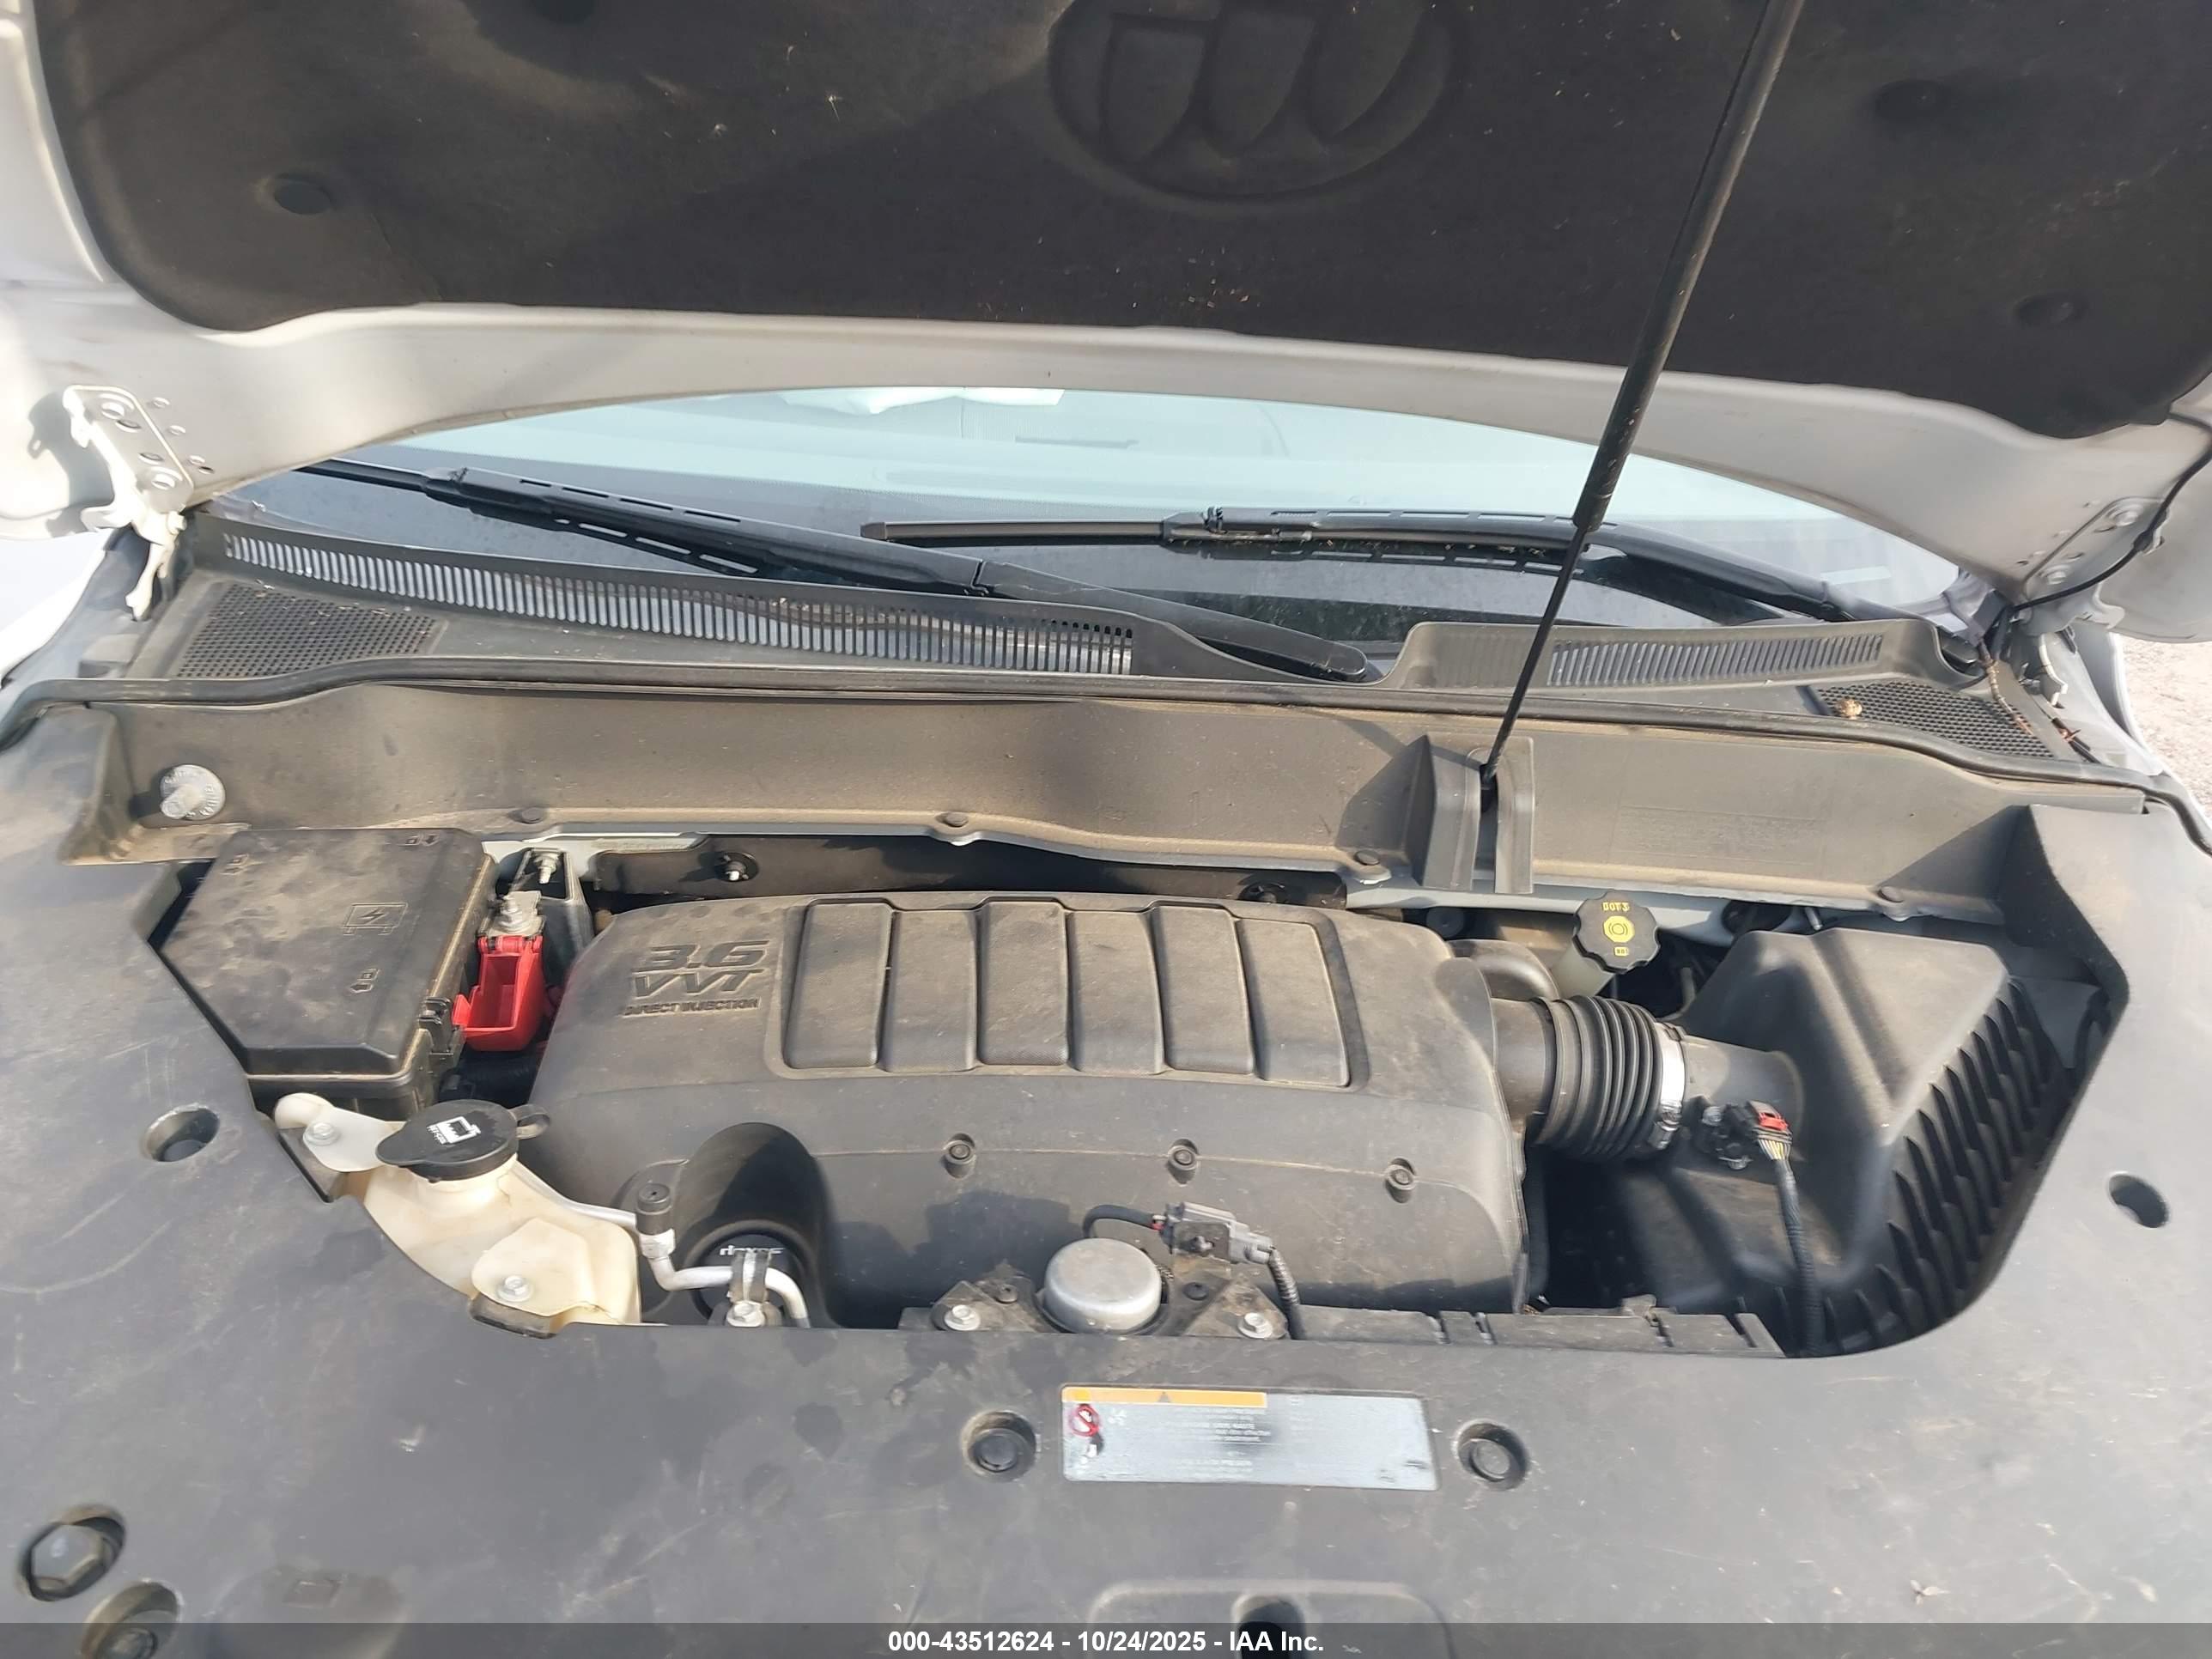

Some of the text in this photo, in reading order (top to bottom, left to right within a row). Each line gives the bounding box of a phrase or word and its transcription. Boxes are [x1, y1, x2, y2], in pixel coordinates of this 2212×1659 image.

[631, 940, 769, 974] 3.6
[634, 969, 768, 999] VVT
[682, 998, 760, 1013] INJECTION
